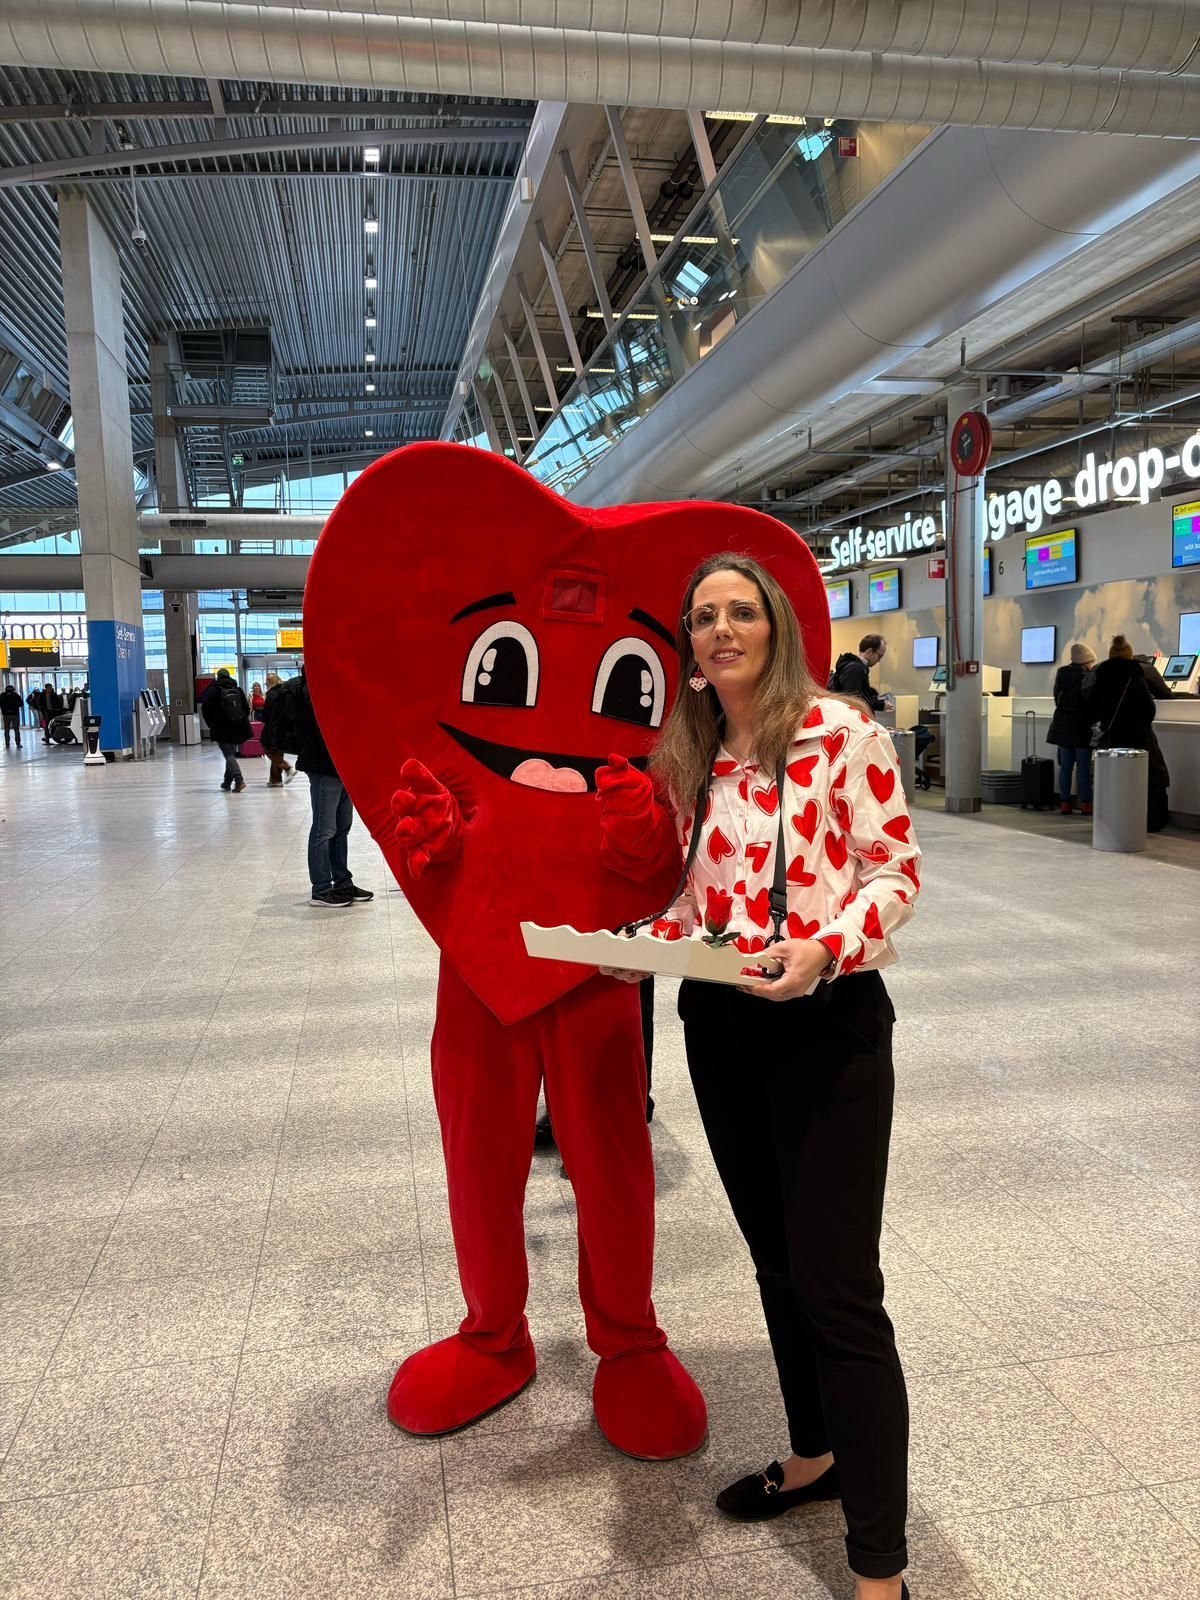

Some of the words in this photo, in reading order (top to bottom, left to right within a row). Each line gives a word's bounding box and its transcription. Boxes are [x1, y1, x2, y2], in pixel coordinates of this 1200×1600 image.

[831, 512, 936, 569] Self-service
[941, 479, 1062, 541] gage
[999, 561, 1004, 575] 6
